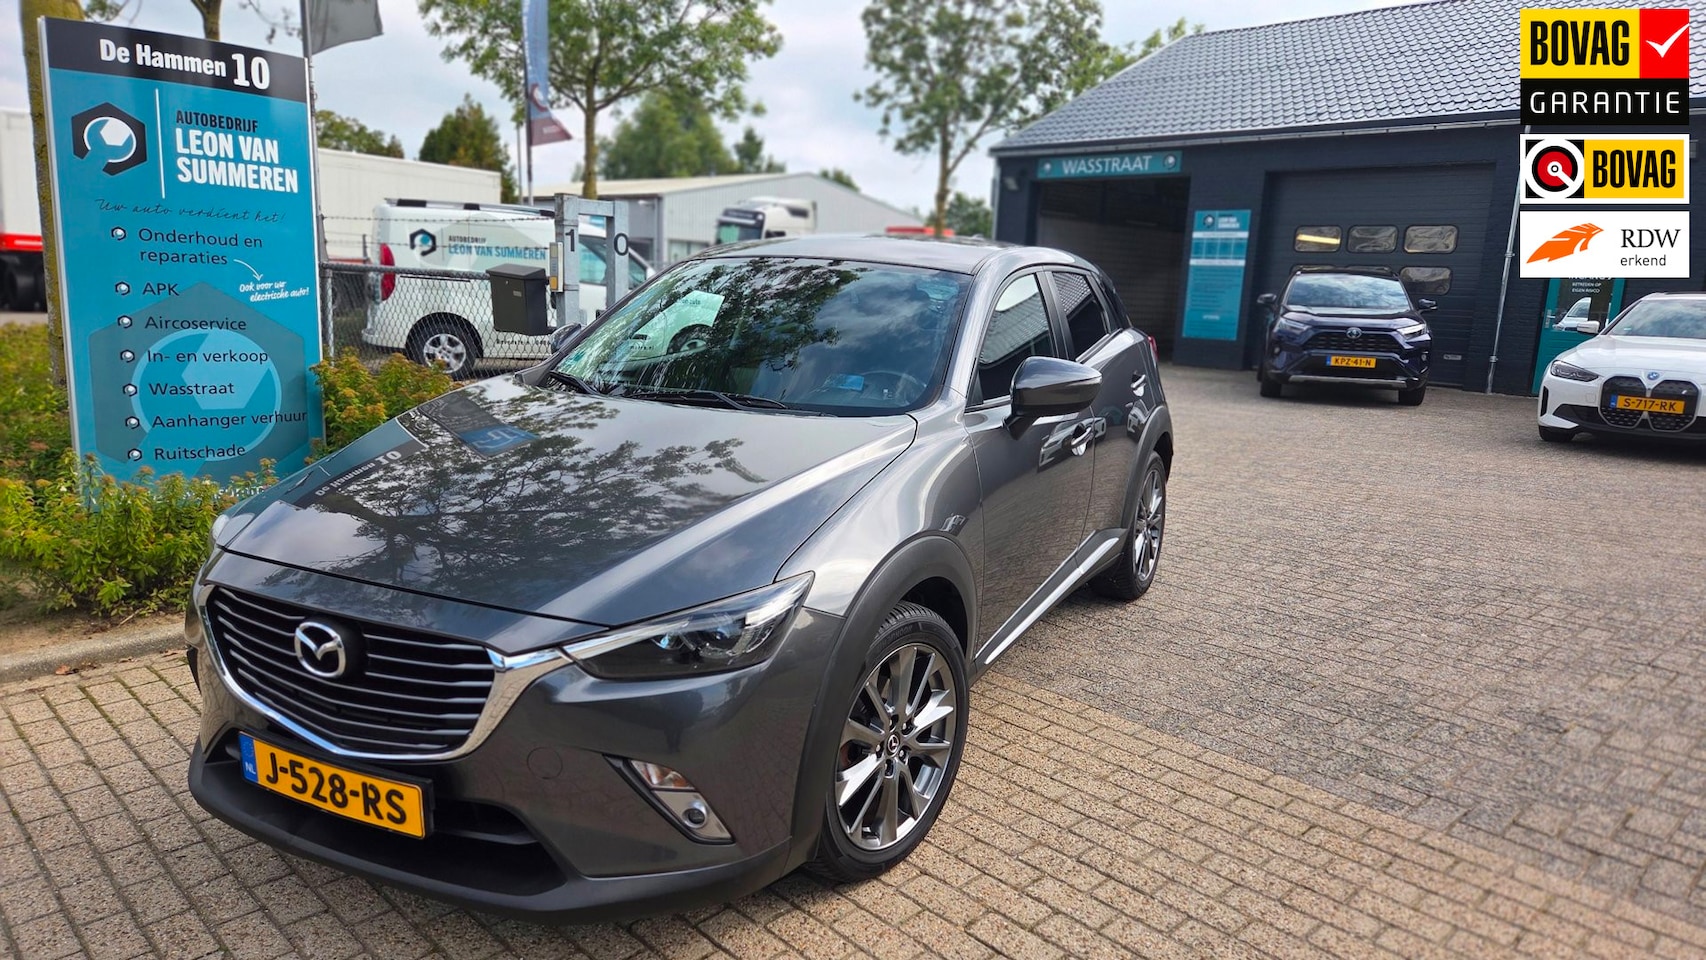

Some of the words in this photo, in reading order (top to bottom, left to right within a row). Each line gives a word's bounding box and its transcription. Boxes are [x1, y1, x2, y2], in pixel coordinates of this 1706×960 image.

[99, 38, 130, 63] De
[136, 44, 227, 78] Hammen
[231, 53, 271, 90] 10
[176, 110, 258, 133] AUTOBEDRIJF
[175, 128, 235, 158] LEON
[238, 135, 279, 164] VAN
[1062, 155, 1152, 175] WASSTRAAT
[177, 157, 298, 193] SUMMEREN
[95, 199, 127, 212] Uw
[132, 204, 172, 216] auto
[178, 207, 250, 221] verdient
[139, 228, 239, 247] Onderhoud
[244, 237, 263, 248] en
[565, 228, 576, 252] 1
[613, 232, 629, 257] 0
[140, 250, 228, 266] reparaties
[448, 243, 472, 255] LEON
[475, 245, 492, 256] VAN
[495, 247, 546, 260] SUMMEREN
[142, 282, 180, 296] APK
[239, 282, 255, 293] Ook
[256, 283, 273, 291] voor
[250, 289, 289, 302] electrische
[145, 316, 247, 331] Aircoservice
[147, 351, 170, 363] In-
[176, 352, 197, 363] en
[203, 350, 269, 365] verkoop
[1333, 358, 1372, 367] KPZ-41-N
[149, 382, 235, 396] Wasstraat
[1623, 398, 1678, 412] S-717-RK
[152, 413, 246, 430] Aanhanger
[251, 411, 307, 425] verhuur
[154, 445, 246, 460] Ruitschade
[244, 761, 257, 775] NL
[266, 752, 407, 825] J-528-RS
